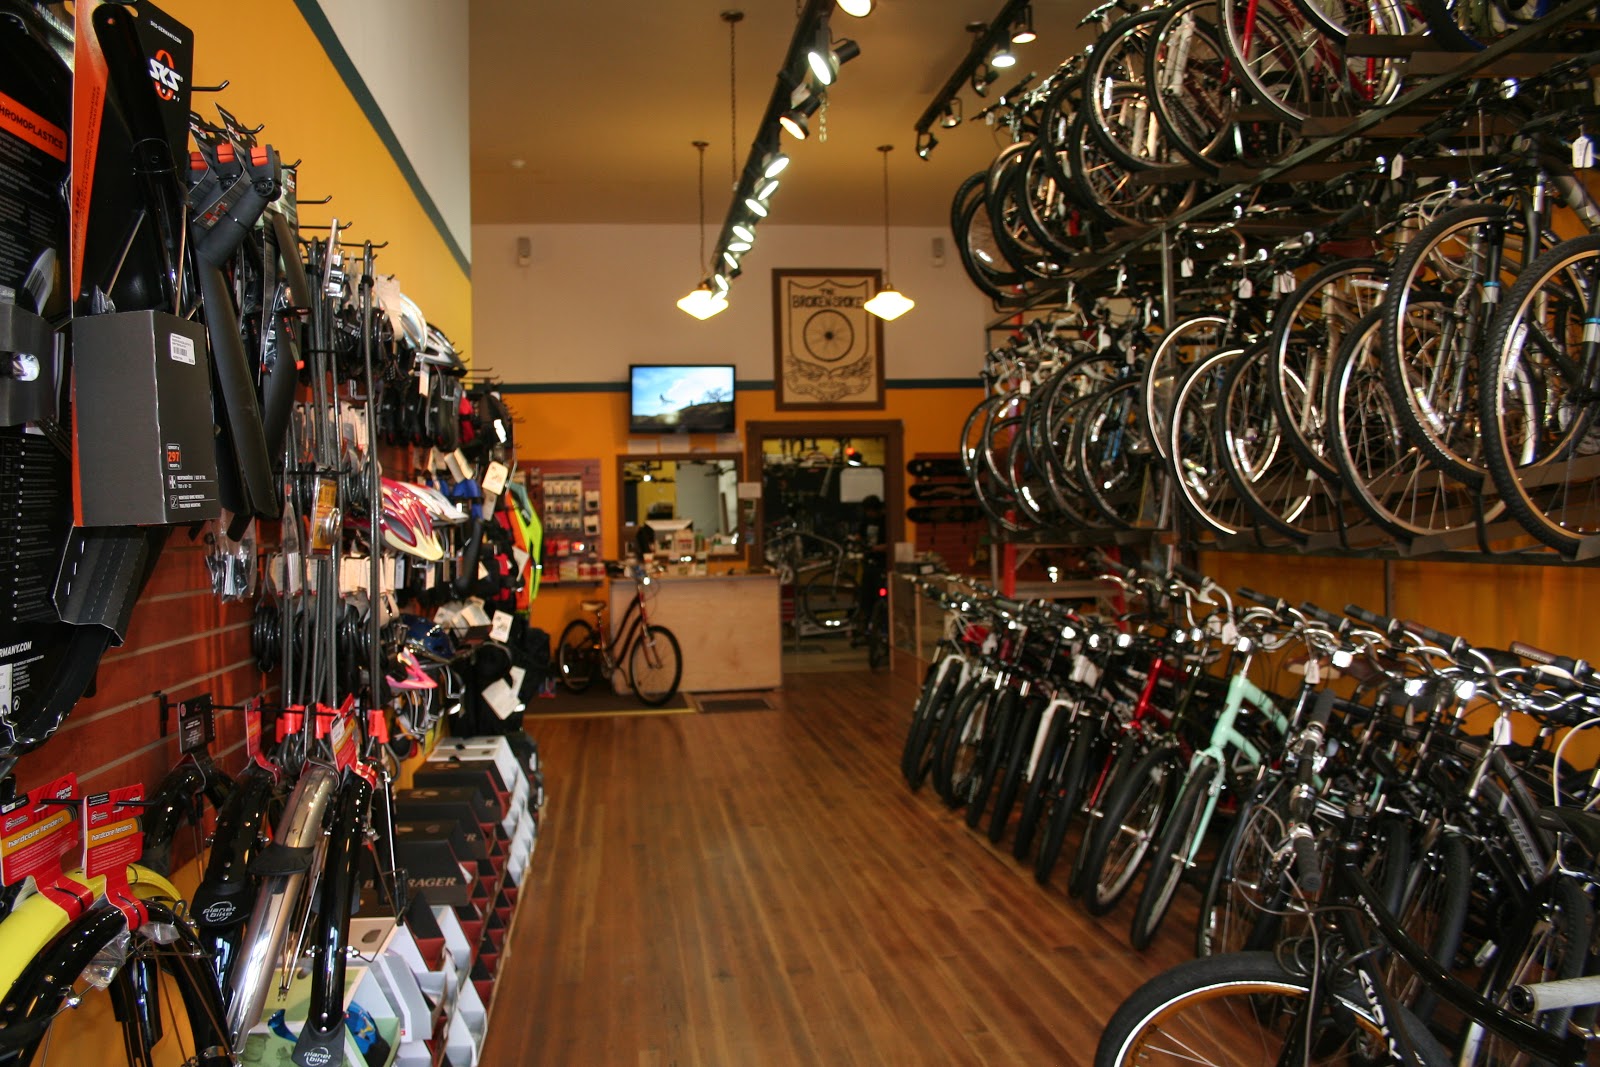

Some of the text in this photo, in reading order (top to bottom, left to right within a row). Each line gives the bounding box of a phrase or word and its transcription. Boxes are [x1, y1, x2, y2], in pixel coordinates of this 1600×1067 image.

[149, 58, 182, 91] SKS
[0, 105, 64, 149] HROMOPLASTICS
[0, 640, 32, 658] RMANY.COM
[8, 829, 40, 848] hardcore
[41, 817, 64, 832] fenders
[91, 823, 132, 842] hardcore fenders
[202, 906, 237, 915] planet
[303, 1051, 332, 1060] planet
[309, 1056, 329, 1064] bike
